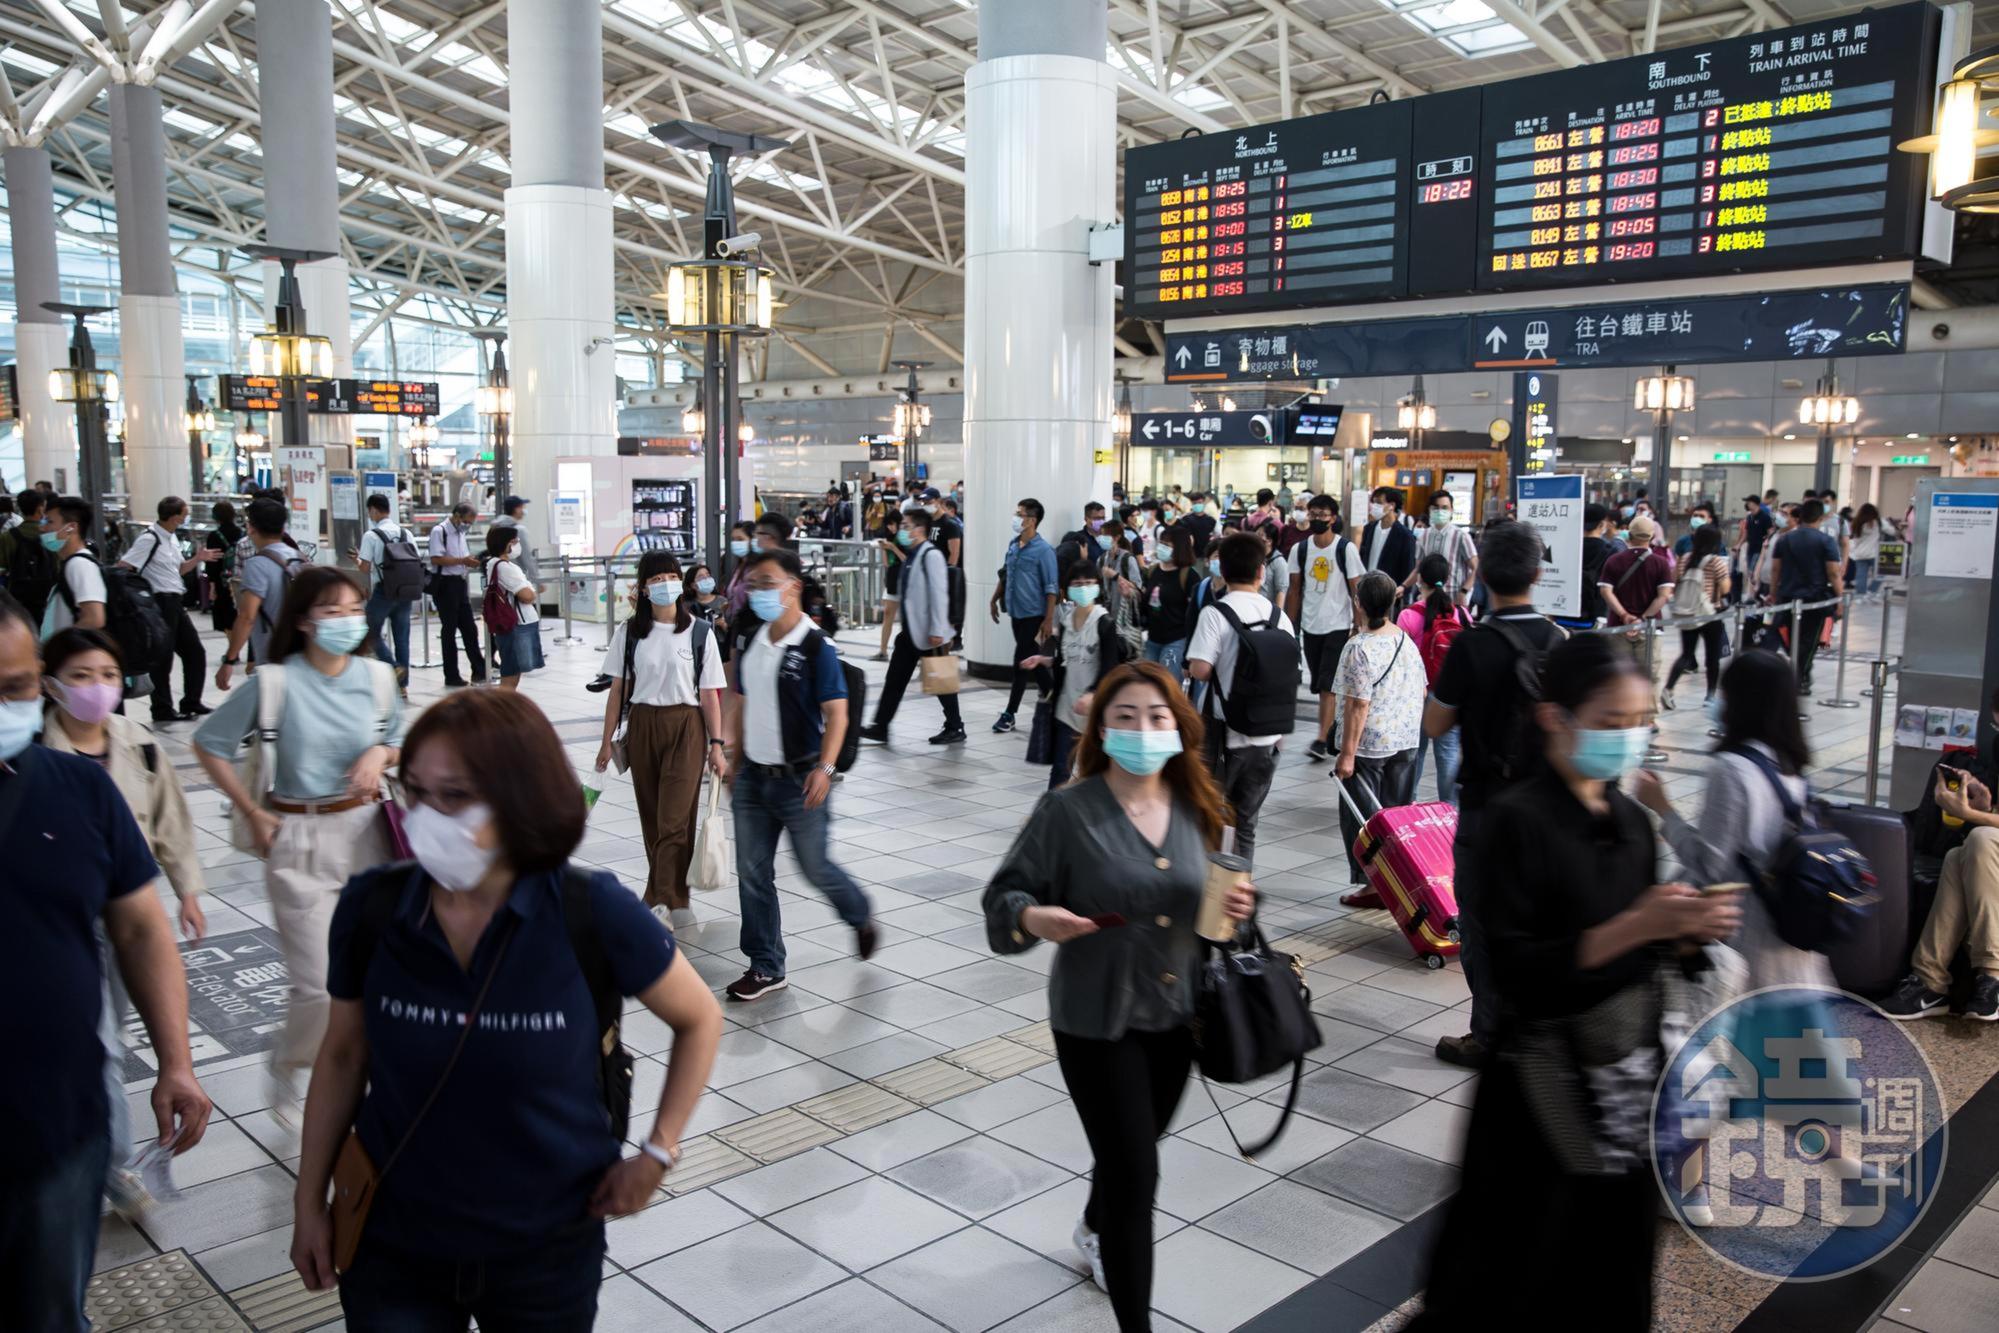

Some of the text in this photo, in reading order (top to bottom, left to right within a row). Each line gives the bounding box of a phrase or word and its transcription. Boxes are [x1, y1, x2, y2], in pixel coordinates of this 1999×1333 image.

[1749, 23, 1870, 59] 列車到站時間
[1750, 42, 1867, 74] TRAIN ARRIVAL TIME
[1648, 71, 1711, 90] SOUTHBOUND
[1780, 78, 1833, 94] INFORMATION
[1638, 107, 1654, 117] TIME
[1674, 100, 1696, 111] DELAY
[1568, 116, 1604, 127] DESTINATION
[1615, 118, 1660, 139] 18:20
[1705, 111, 1718, 126] 2
[1515, 127, 1533, 136] TRAIN
[1235, 146, 1277, 158] NORTHBOUND
[1614, 142, 1659, 163] 18:25
[1709, 135, 1717, 149] 1
[1722, 127, 1771, 150] 終點站
[1613, 168, 1657, 187] 18:30
[1703, 161, 1715, 177] 3
[1720, 153, 1770, 176] 終點站
[1215, 181, 1245, 198] 18:25
[1424, 180, 1472, 202] 18:22
[1612, 192, 1656, 211] 18:45
[1702, 186, 1715, 202] 3
[1719, 179, 1768, 202] 終點站
[1215, 202, 1245, 217] 18:55
[1214, 222, 1245, 237] 19:00
[1275, 216, 1283, 231] 3
[1611, 217, 1655, 237] 19:05
[1706, 212, 1713, 225] 1
[1717, 205, 1767, 227] 終點站
[1214, 242, 1244, 257] 19:15
[1274, 237, 1283, 251] 3
[1610, 242, 1653, 261] 19:20
[1699, 236, 1711, 252] 3
[1716, 231, 1765, 252] 終點站
[1213, 261, 1244, 277] 19:25
[1213, 281, 1244, 297] 19:55
[1575, 310, 1693, 339] 往台鐵車站
[1239, 335, 1287, 356] 寄物櫃
[1575, 342, 1599, 356] TRA
[331, 380, 340, 399] 1
[1163, 419, 1195, 438] 1-6
[1528, 503, 1568, 518] 進站入口
[186, 973, 259, 1018] Elevator
[379, 996, 567, 1032] TOMMY HILFIGER
